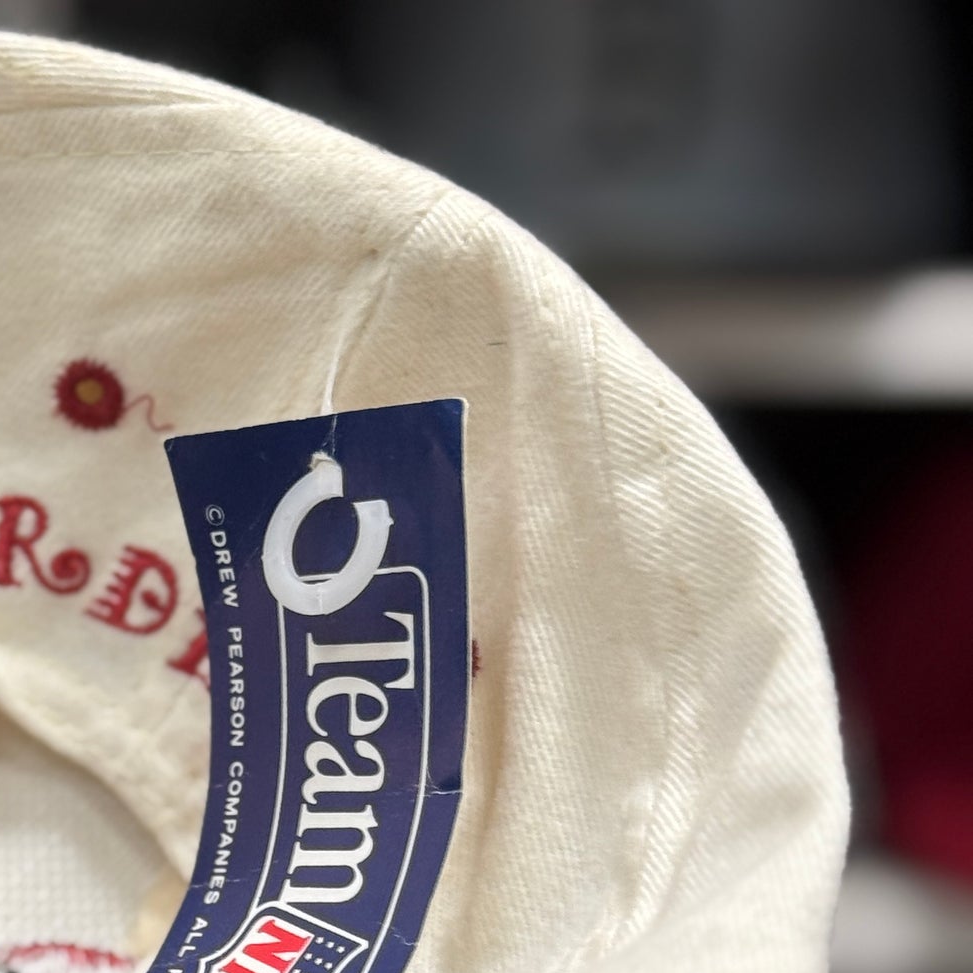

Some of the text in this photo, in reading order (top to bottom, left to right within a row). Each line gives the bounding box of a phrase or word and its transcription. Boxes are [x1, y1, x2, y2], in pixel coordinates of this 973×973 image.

[226, 627, 246, 748] PEARSON
[279, 611, 415, 903] Team
[203, 760, 244, 905] COMPANIES
[177, 916, 209, 958] ALL
